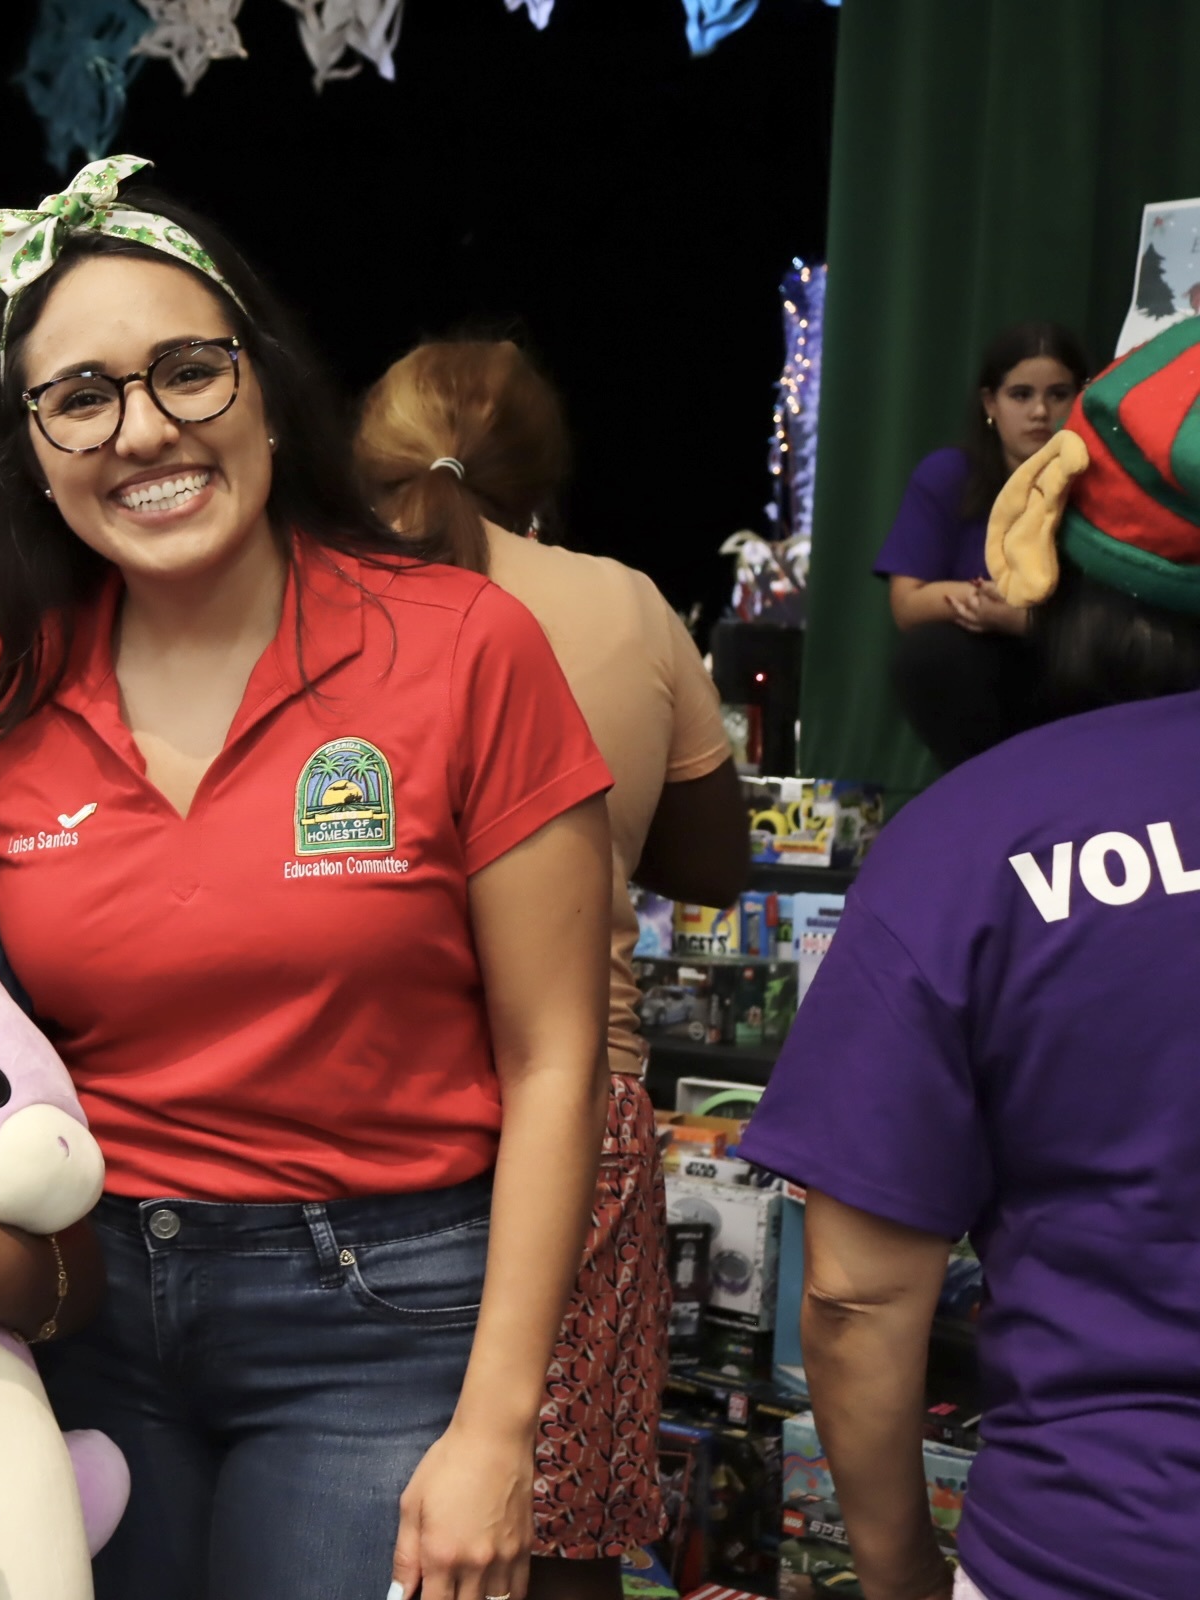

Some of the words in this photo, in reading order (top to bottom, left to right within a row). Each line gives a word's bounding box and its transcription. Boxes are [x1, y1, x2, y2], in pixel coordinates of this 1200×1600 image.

[325, 742, 360, 754] FLORIDA
[307, 827, 383, 842] HOMESTEAD
[320, 820, 348, 831] CITY
[353, 819, 370, 828] OF
[7, 834, 35, 854] Loisa
[37, 829, 79, 850] Santos
[284, 859, 343, 879] Education
[346, 855, 409, 874] Committee
[1008, 821, 1200, 923] VOL
